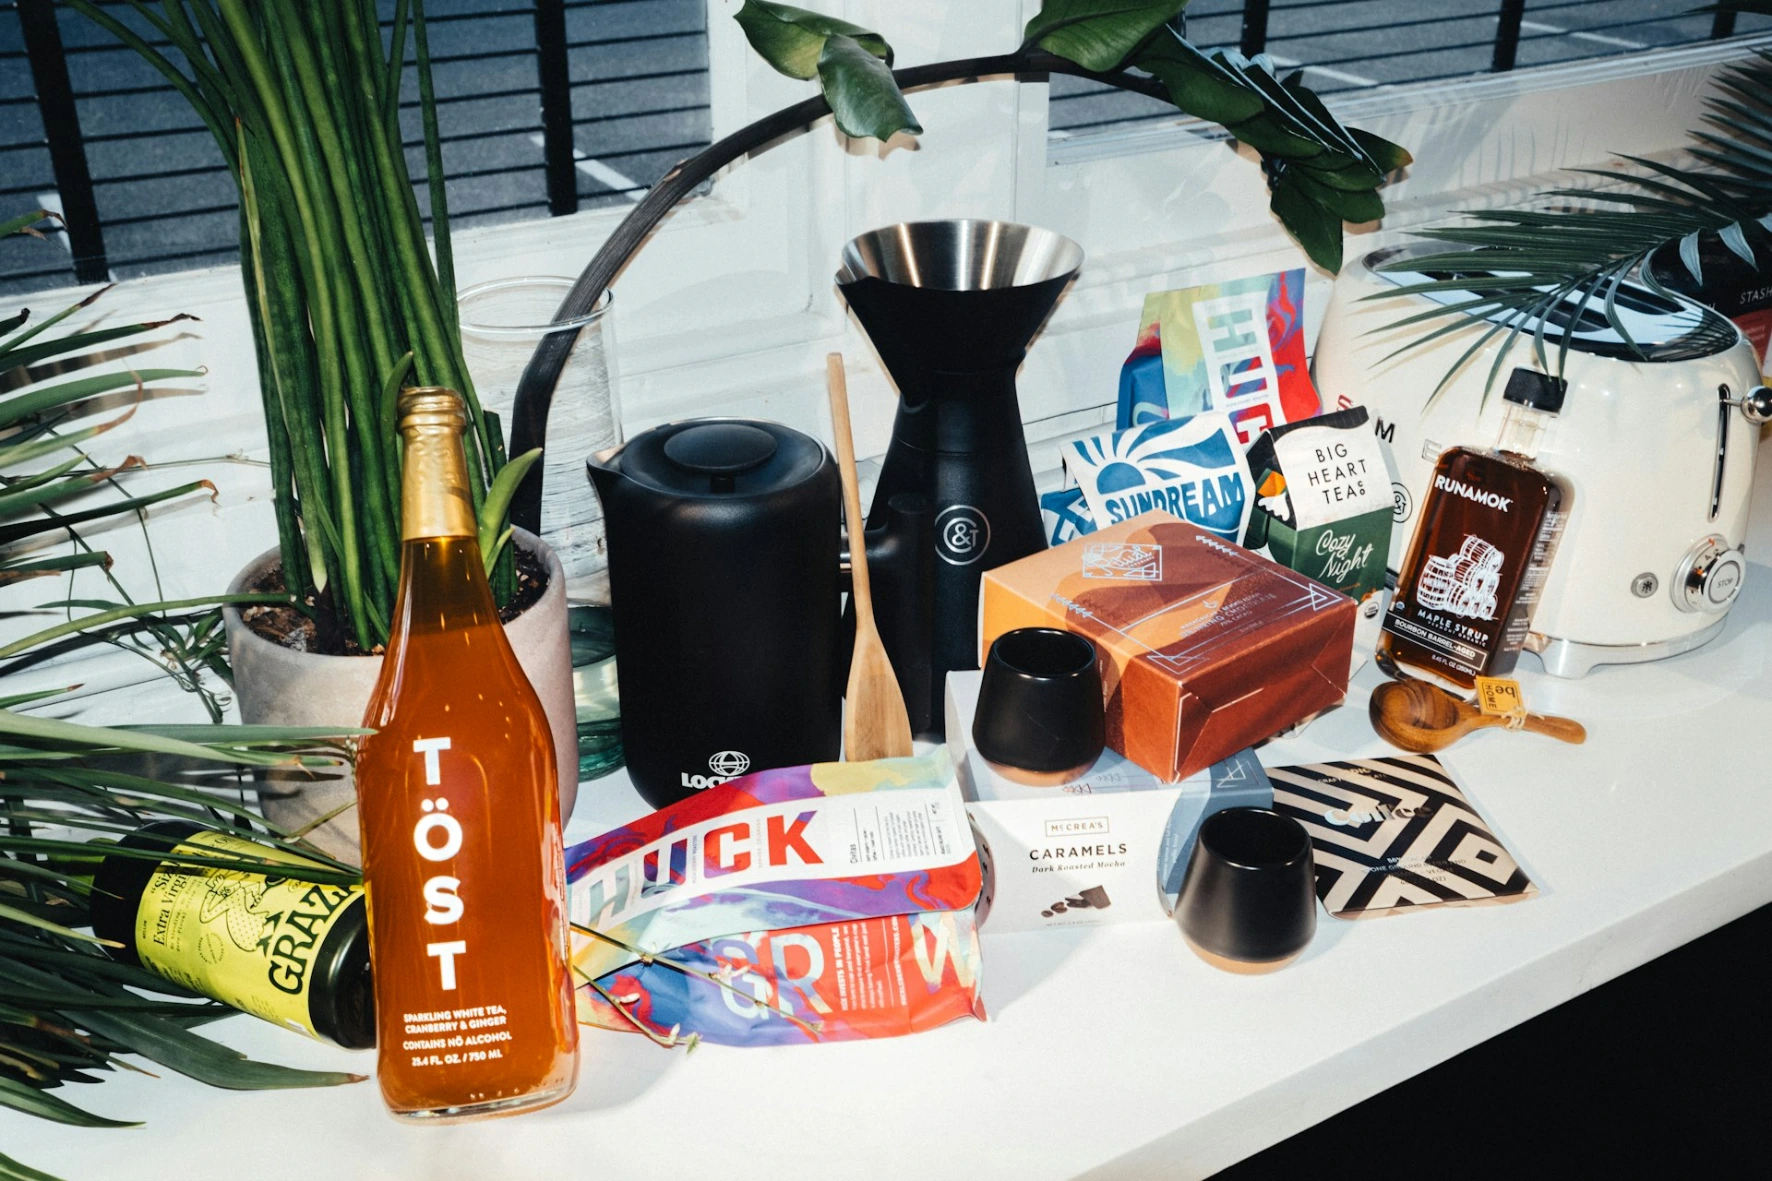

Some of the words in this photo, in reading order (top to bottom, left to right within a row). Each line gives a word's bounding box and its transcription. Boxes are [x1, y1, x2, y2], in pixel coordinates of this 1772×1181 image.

[1207, 308, 1274, 444] HUC
[1316, 443, 1348, 463] BIG
[1308, 459, 1368, 486] HEART
[1105, 472, 1245, 525] SUNDREAM
[1322, 485, 1357, 504] TEA
[1434, 474, 1511, 512] RUNAMOK
[1316, 529, 1356, 558] Cozy
[1318, 543, 1374, 583] Night
[1717, 578, 1734, 588] STOP
[1417, 609, 1451, 629] MAPLE
[1455, 624, 1489, 642] SYRUP
[1428, 621, 1456, 634] VERMONT
[1458, 633, 1487, 647] ORGANIC
[1394, 619, 1427, 637] BOURBON
[1427, 632, 1476, 658] BARREL-AGED
[1485, 684, 1497, 709] HOME
[1495, 685, 1516, 698] be
[681, 771, 742, 790] LOC
[412, 737, 467, 991] TÖST
[1029, 843, 1128, 861] CARAMELS
[1032, 866, 1054, 874] Dark
[1057, 862, 1094, 872] Roasted
[1096, 860, 1125, 869] Mocha
[153, 909, 170, 946] Extra
[162, 868, 190, 904] Virgi
[268, 884, 357, 995] GRAZ
[831, 927, 842, 958] PEOPLE
[835, 959, 843, 968] IN
[403, 1011, 452, 1023] SPARKLING
[453, 1006, 484, 1019] WHITE
[486, 1005, 507, 1015] TEA,
[405, 1022, 458, 1034] CRANBERRY
[460, 1021, 467, 1030] &
[468, 1016, 506, 1029] GINGER
[403, 1039, 446, 1050] CONTAINS
[465, 1031, 512, 1046] ALCOHOL
[469, 1051, 486, 1061] 750
[488, 1049, 503, 1059] ML
